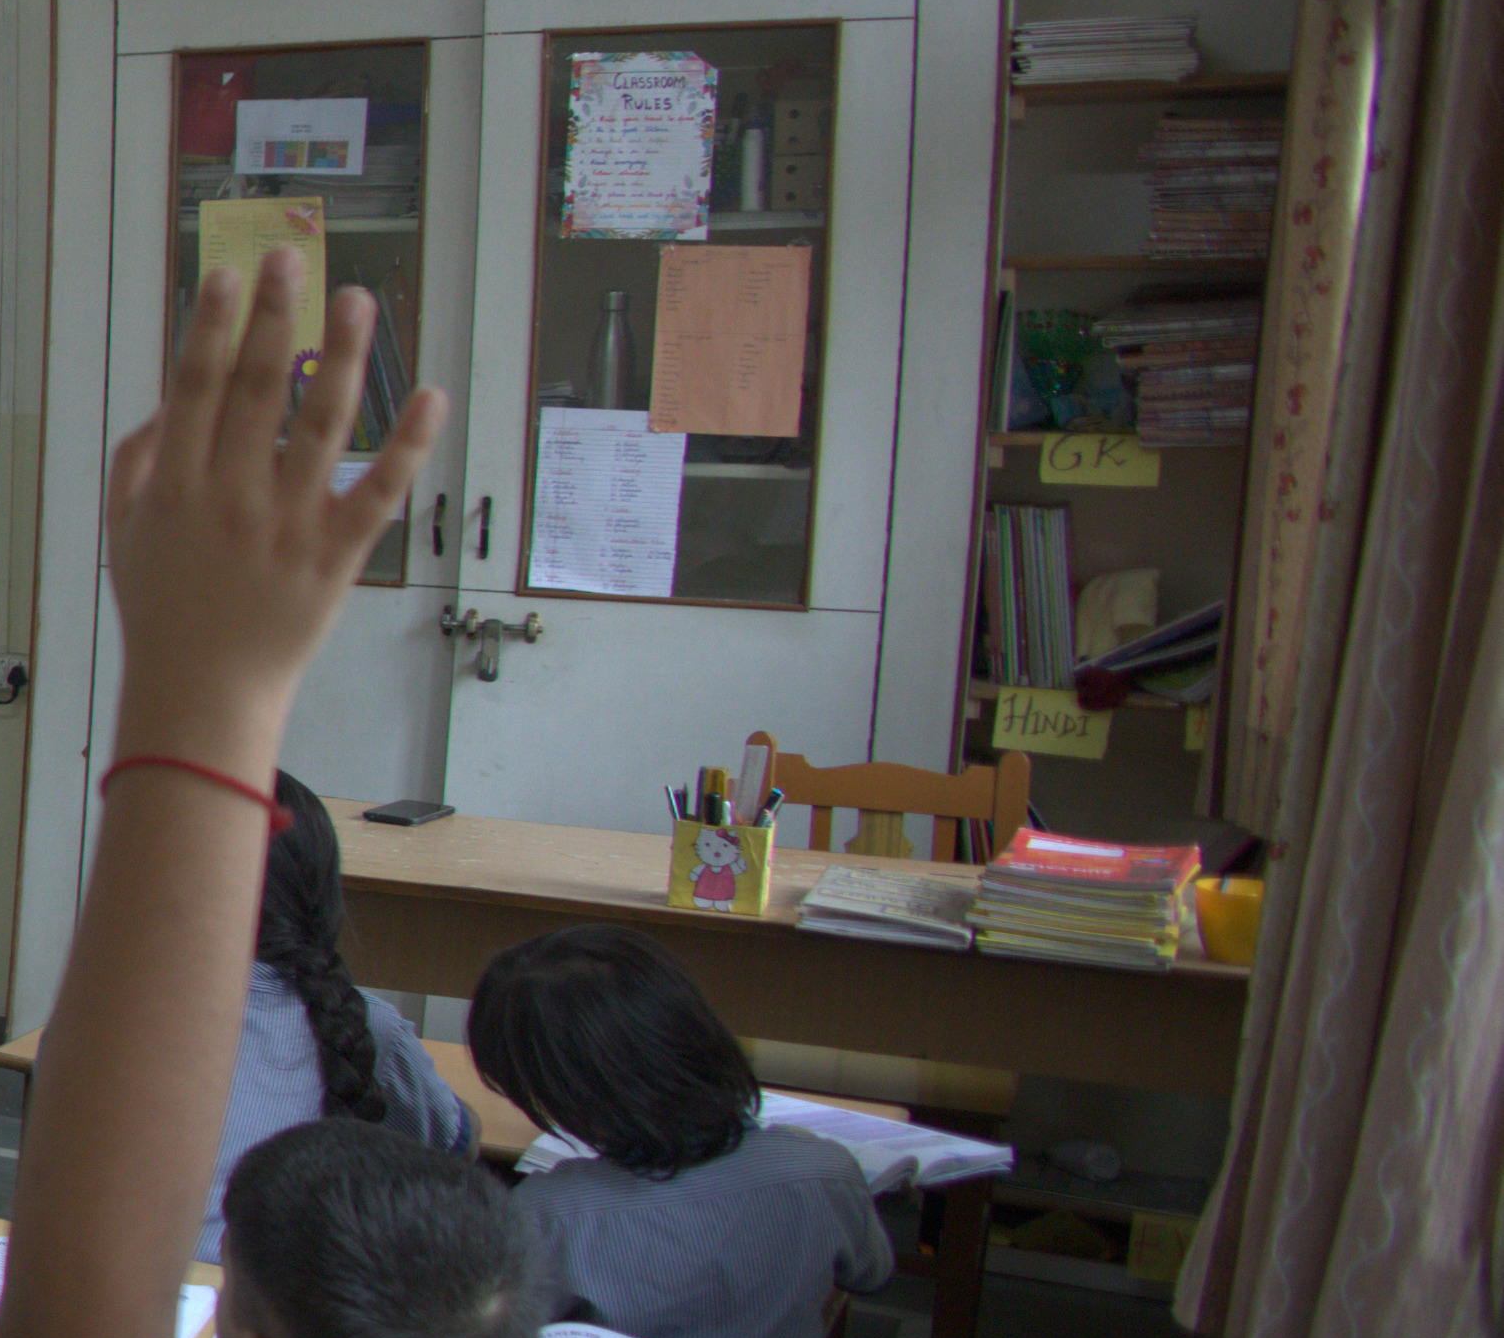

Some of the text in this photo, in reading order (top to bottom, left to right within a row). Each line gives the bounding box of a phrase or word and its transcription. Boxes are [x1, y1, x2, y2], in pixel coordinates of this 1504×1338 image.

[612, 72, 686, 90] CLASSROOM
[621, 94, 674, 111] RULES
[1002, 692, 1091, 738] HINDI
